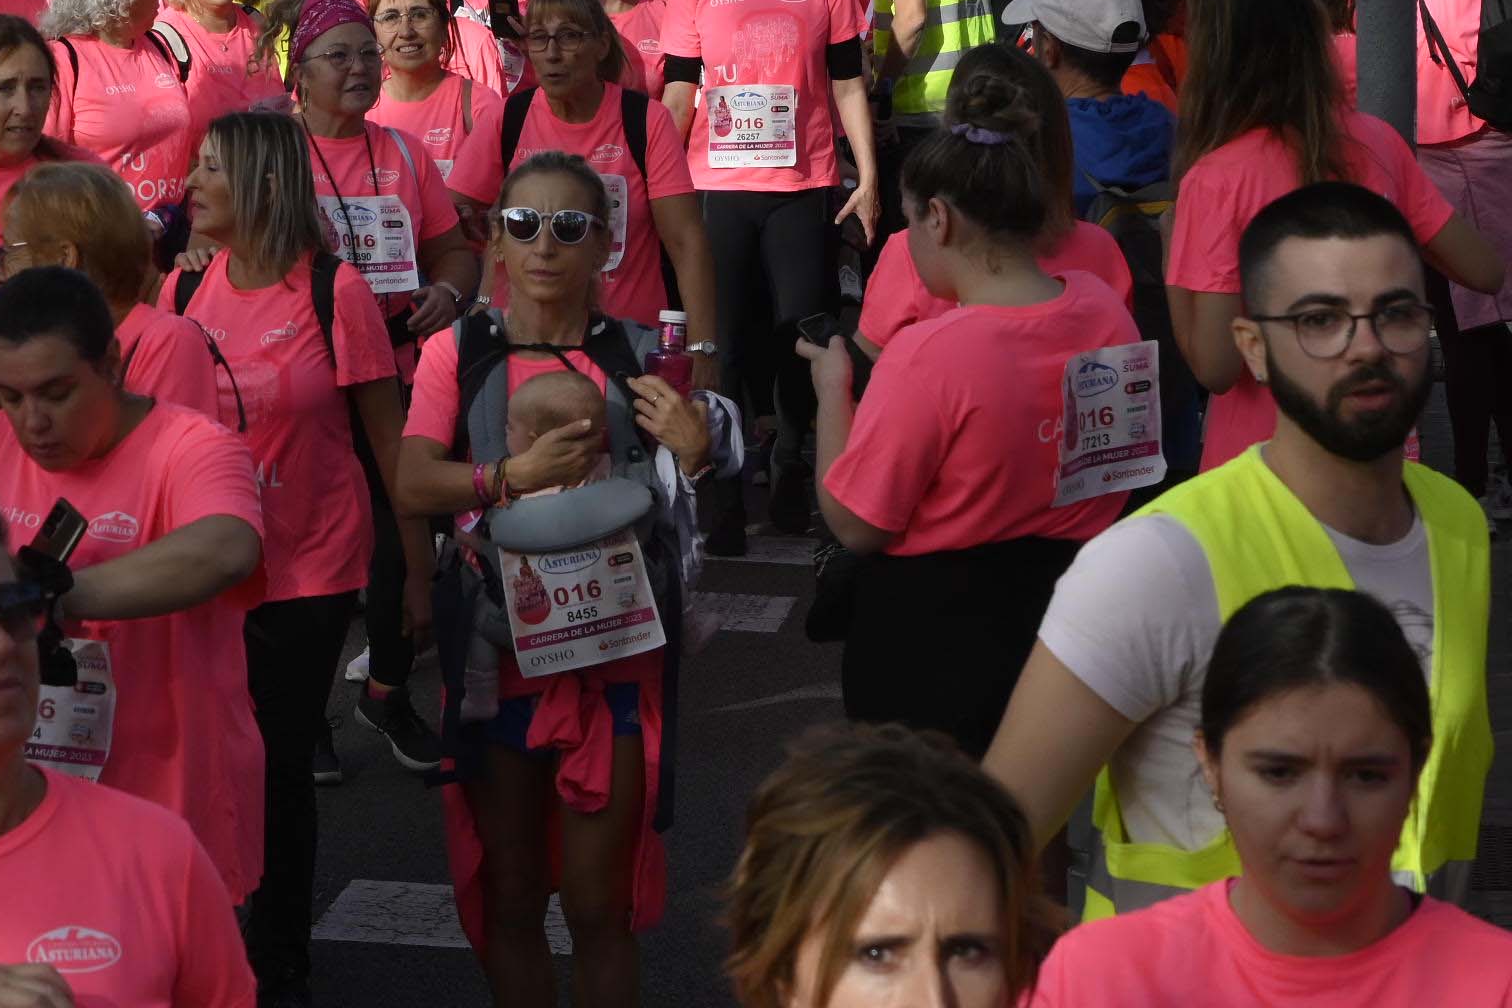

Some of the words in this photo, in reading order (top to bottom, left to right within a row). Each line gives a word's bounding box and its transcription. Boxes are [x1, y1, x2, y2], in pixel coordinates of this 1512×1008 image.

[734, 118, 764, 129] 016
[736, 133, 760, 141] 26257
[342, 234, 376, 249] 016
[1123, 362, 1149, 373] SUMA
[1112, 465, 1155, 482] Santander
[543, 552, 598, 570] ASTURIANA
[553, 579, 602, 606] 016
[567, 607, 598, 623] 8455
[529, 631, 570, 646] CARRERA
[572, 629, 584, 639] DE
[585, 626, 595, 636] LA
[596, 619, 622, 633] MUJER
[623, 614, 643, 625] 2023
[608, 631, 652, 649] Santander
[530, 650, 575, 668] OYSHO
[35, 748, 66, 759] MUJER
[35, 943, 117, 963] ASTURIANA
